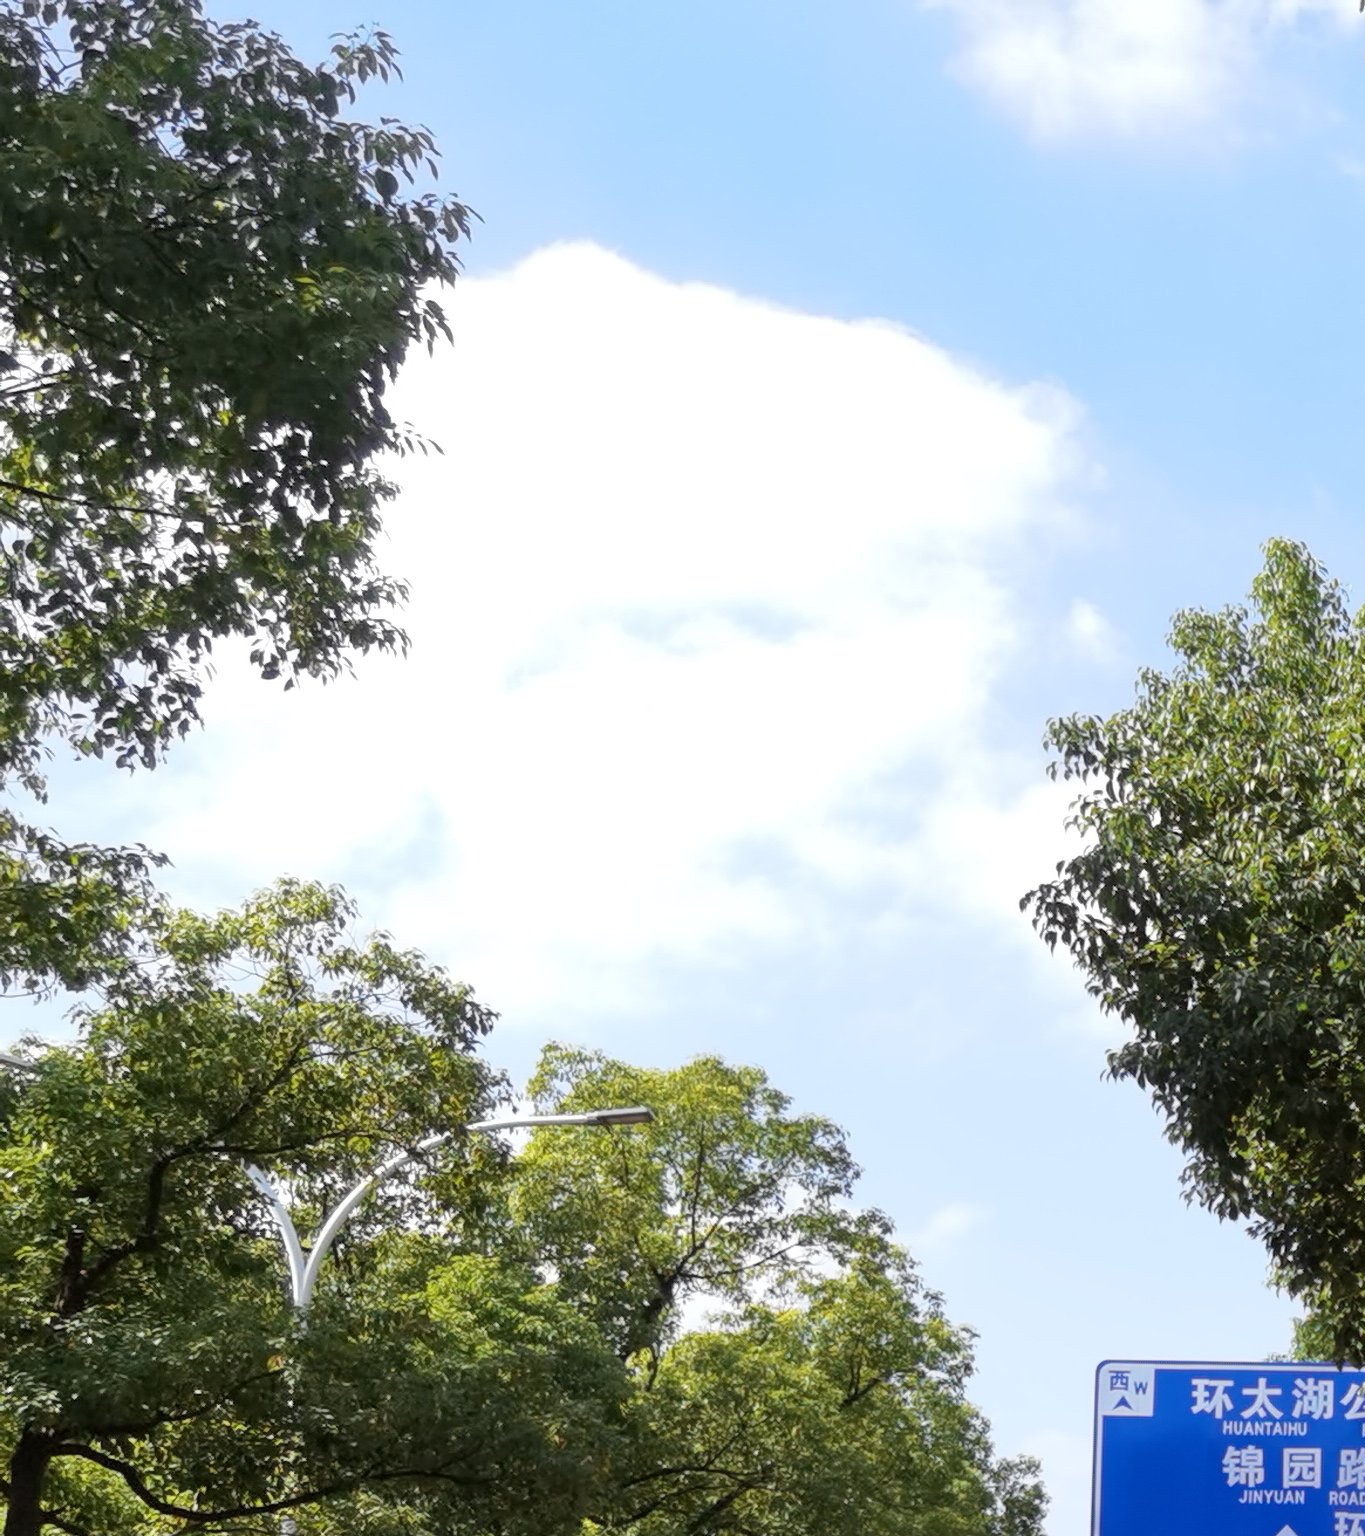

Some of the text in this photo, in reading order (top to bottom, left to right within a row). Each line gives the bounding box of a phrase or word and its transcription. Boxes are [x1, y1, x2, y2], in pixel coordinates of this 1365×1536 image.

[1108, 1370, 1131, 1391] 西
[1134, 1381, 1149, 1395] W
[1222, 1420, 1308, 1437] HUANTAIHU
[1238, 1490, 1305, 1505] JINYUAN
